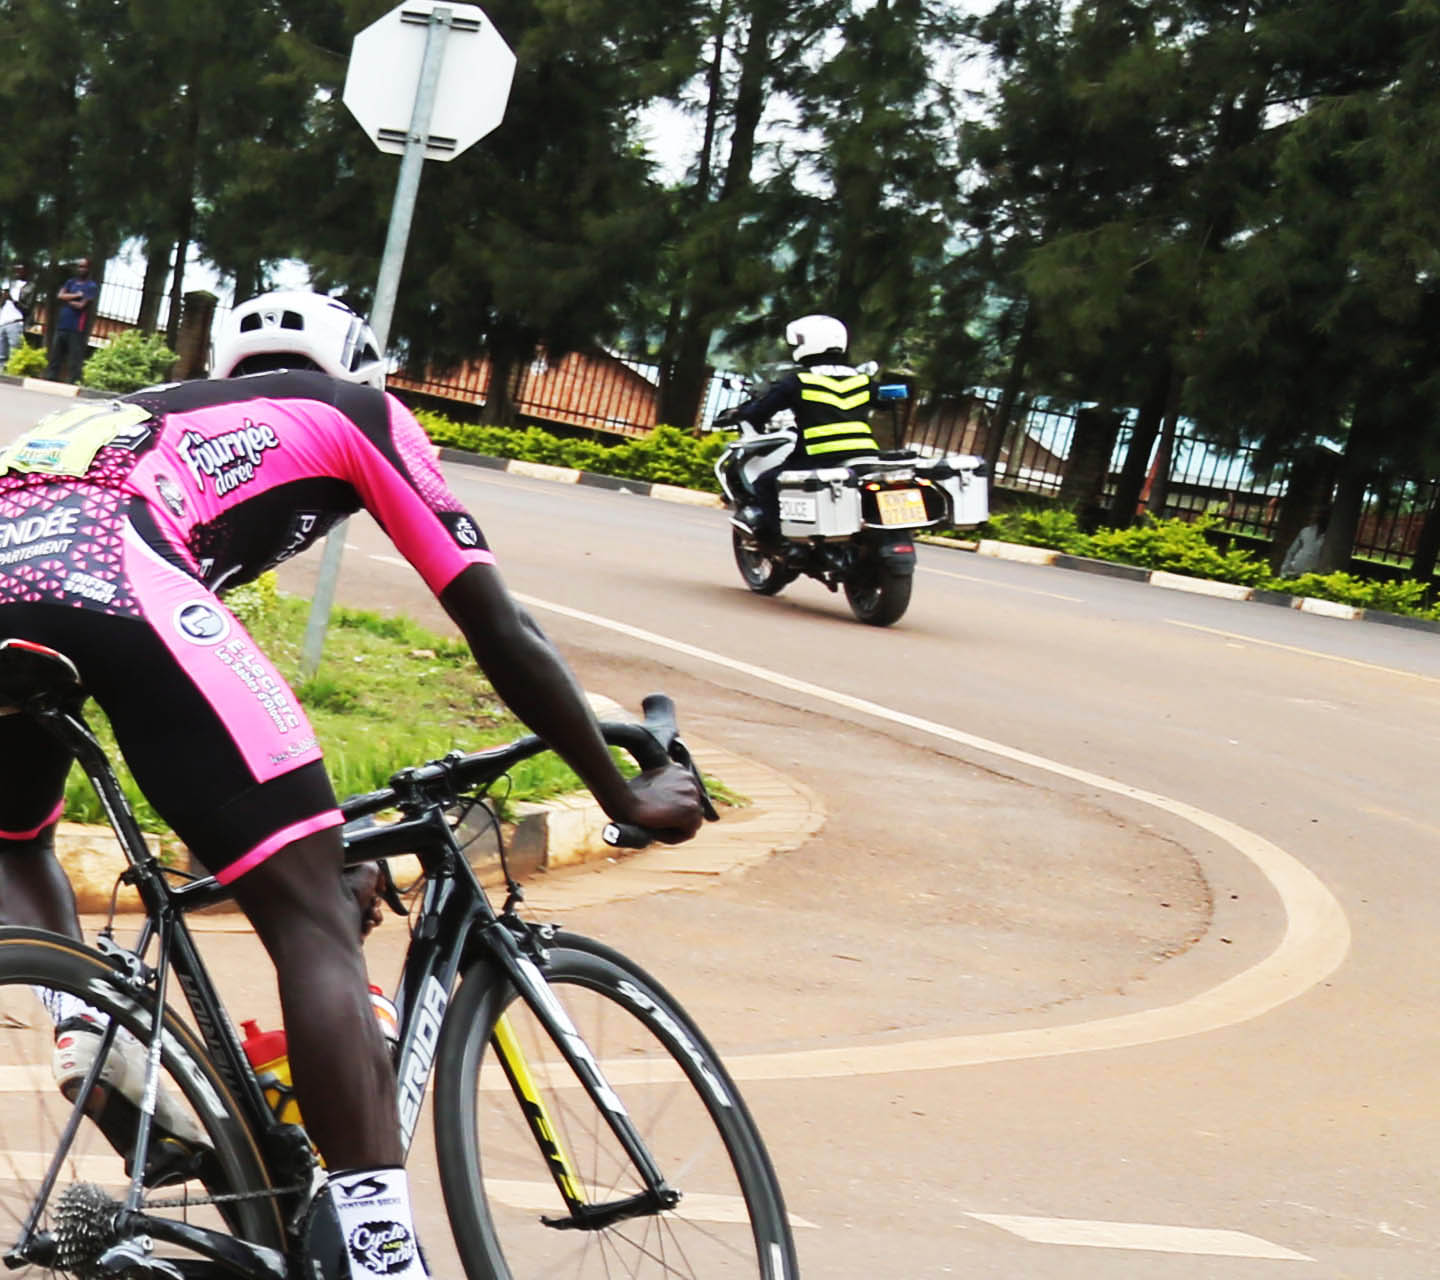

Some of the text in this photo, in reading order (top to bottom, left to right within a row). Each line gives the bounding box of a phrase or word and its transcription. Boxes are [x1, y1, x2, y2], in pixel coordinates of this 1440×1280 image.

[177, 418, 280, 492] Fournée
[214, 461, 256, 497] dorée
[398, 975, 449, 1150] ERIDA
[352, 1222, 407, 1251] Cycle
[382, 1240, 405, 1251] AND
